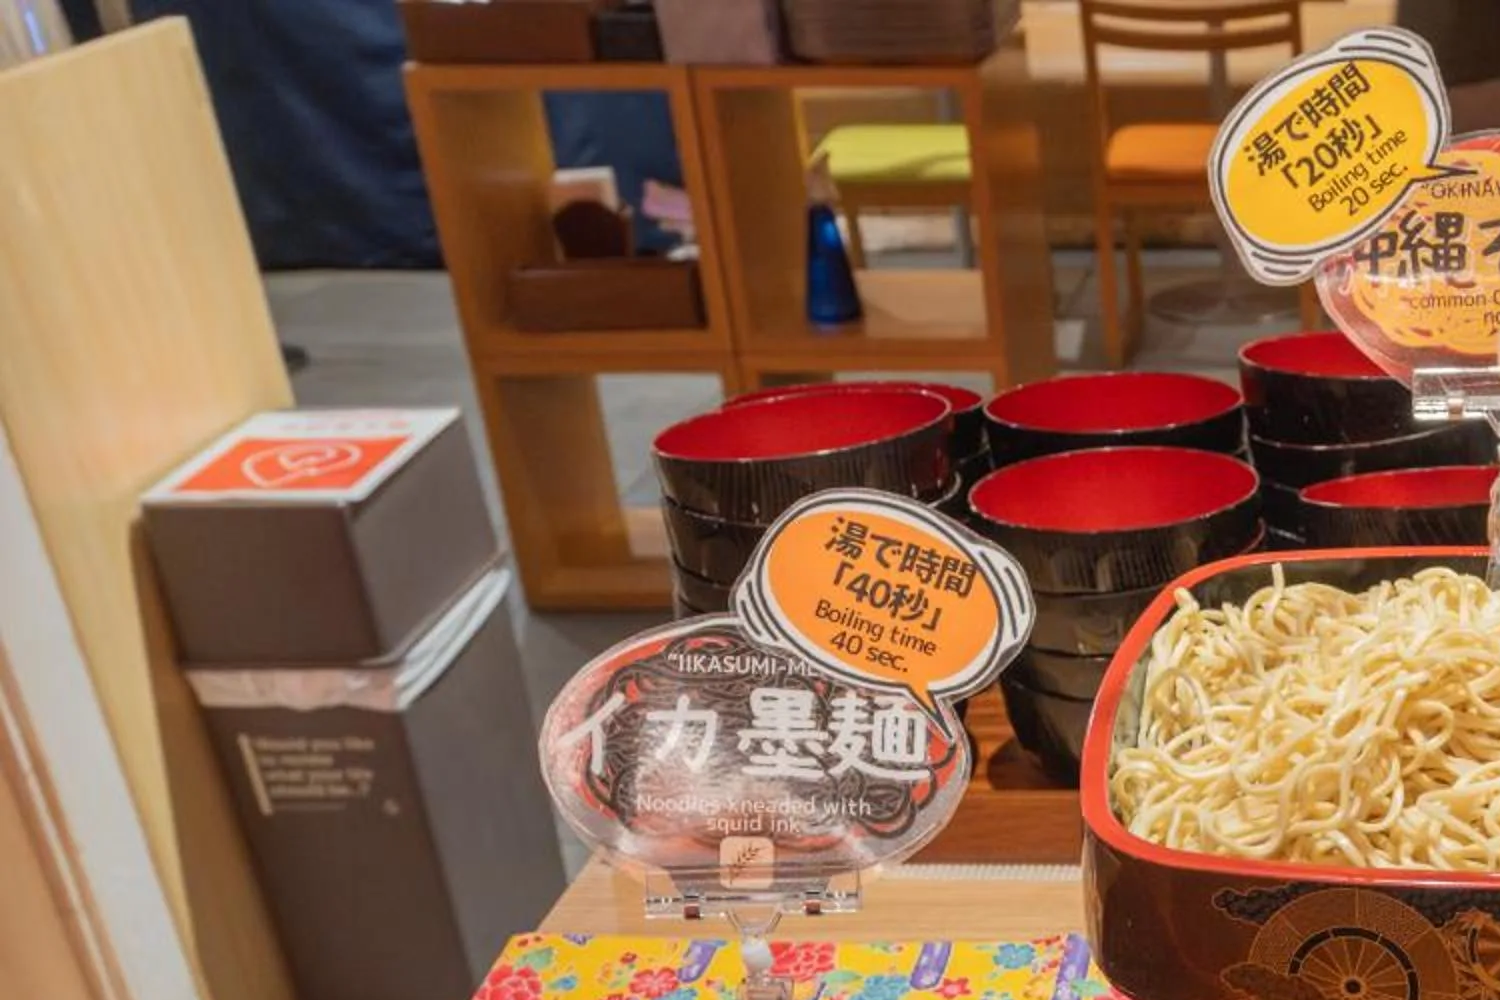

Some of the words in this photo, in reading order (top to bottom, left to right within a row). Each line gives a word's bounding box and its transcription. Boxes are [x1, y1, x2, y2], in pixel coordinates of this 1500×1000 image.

[1243, 61, 1371, 176] 湯で時間
[1281, 114, 1382, 188] 「20秒」
[1308, 162, 1369, 213] Boiling
[1366, 129, 1408, 166] time
[1339, 186, 1370, 216] 20
[1369, 162, 1409, 194] sec.
[1410, 291, 1487, 308] common
[824, 516, 978, 598] 湯で時間
[815, 598, 885, 642] Boiling
[889, 625, 937, 656] time
[833, 561, 942, 632] 「40秒」
[830, 630, 863, 655] 40
[865, 645, 908, 672] sec.
[556, 687, 931, 782] イカ墨麺
[706, 813, 763, 835] squid
[770, 815, 800, 832] ink
[722, 797, 815, 816] kneaded
[822, 799, 872, 817] with
